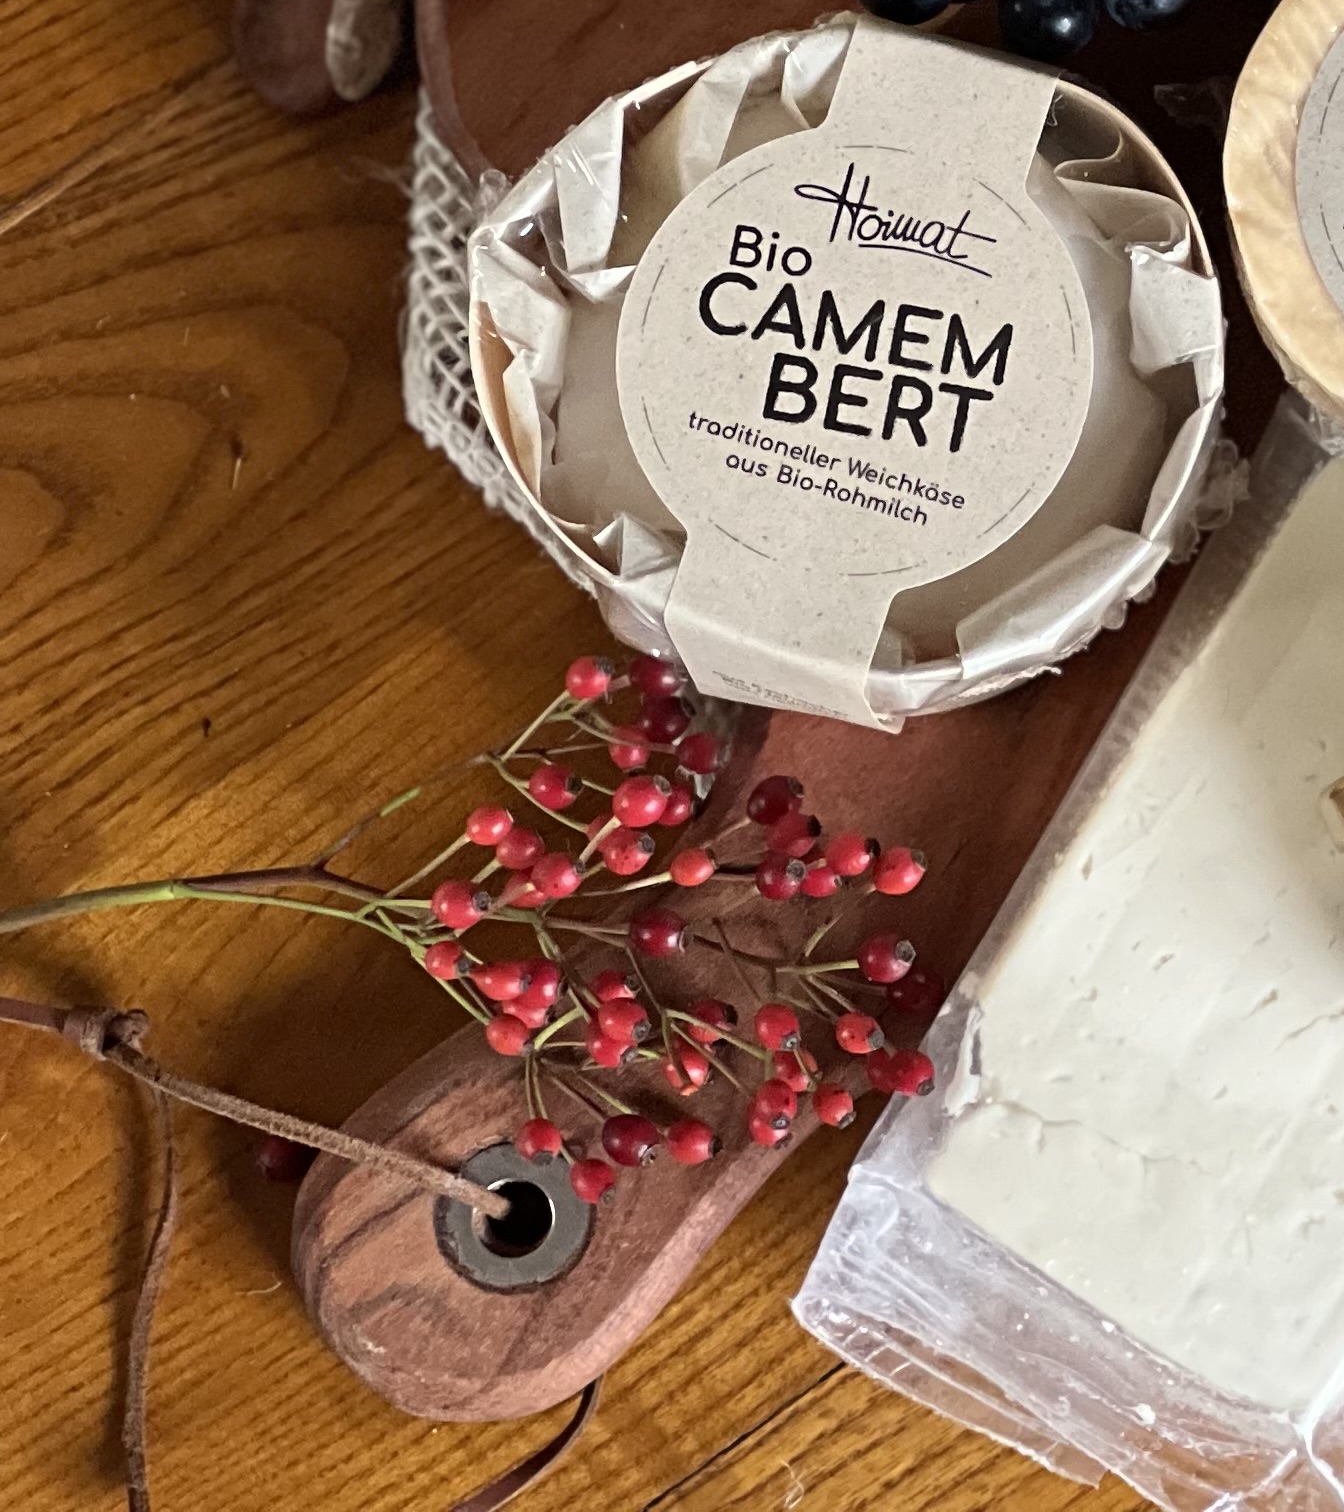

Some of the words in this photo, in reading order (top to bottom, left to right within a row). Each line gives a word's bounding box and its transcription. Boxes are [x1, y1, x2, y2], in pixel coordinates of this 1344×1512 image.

[728, 224, 813, 277] Bio
[794, 163, 998, 262] Hoimat
[698, 273, 1015, 386] CAMEM
[762, 353, 994, 453] BERT
[688, 411, 842, 471] traditioneller
[846, 458, 967, 511] Weichkäse
[725, 455, 770, 480] aus
[775, 464, 929, 526] Bio-Rohmilch
